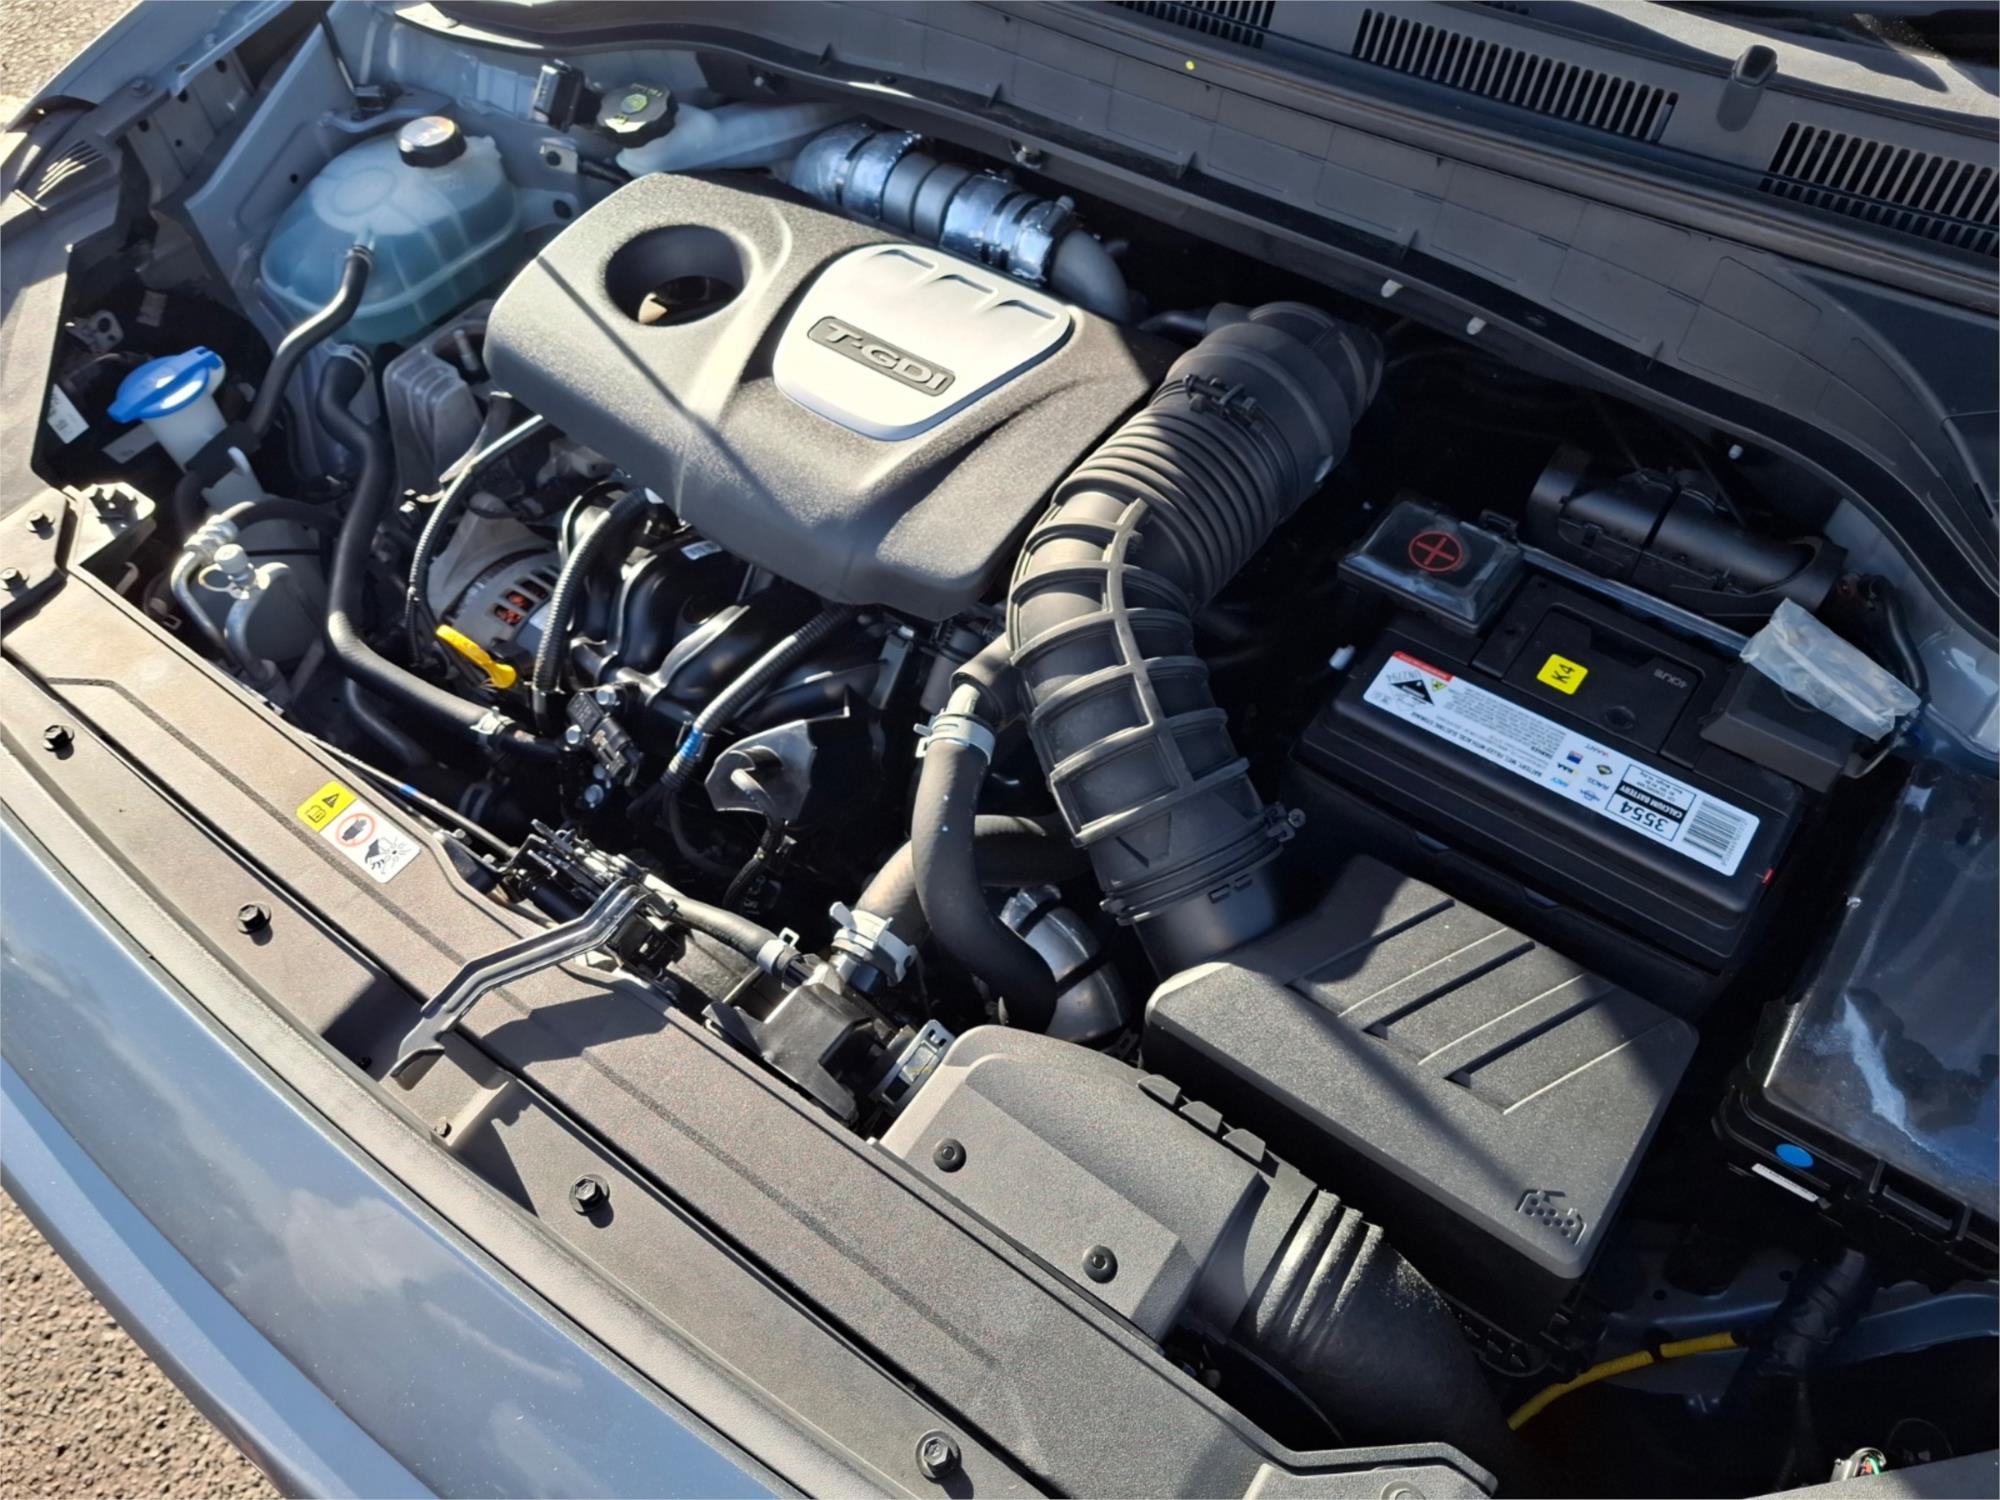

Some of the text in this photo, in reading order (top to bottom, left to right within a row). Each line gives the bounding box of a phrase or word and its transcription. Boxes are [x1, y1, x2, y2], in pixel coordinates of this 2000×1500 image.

[827, 323, 948, 390] T-GDI
[1551, 664, 1576, 684] K4
[1619, 784, 1650, 803] BATTERY
[1620, 801, 1669, 832] 3554
[1650, 799, 1682, 818] CALCIUM
